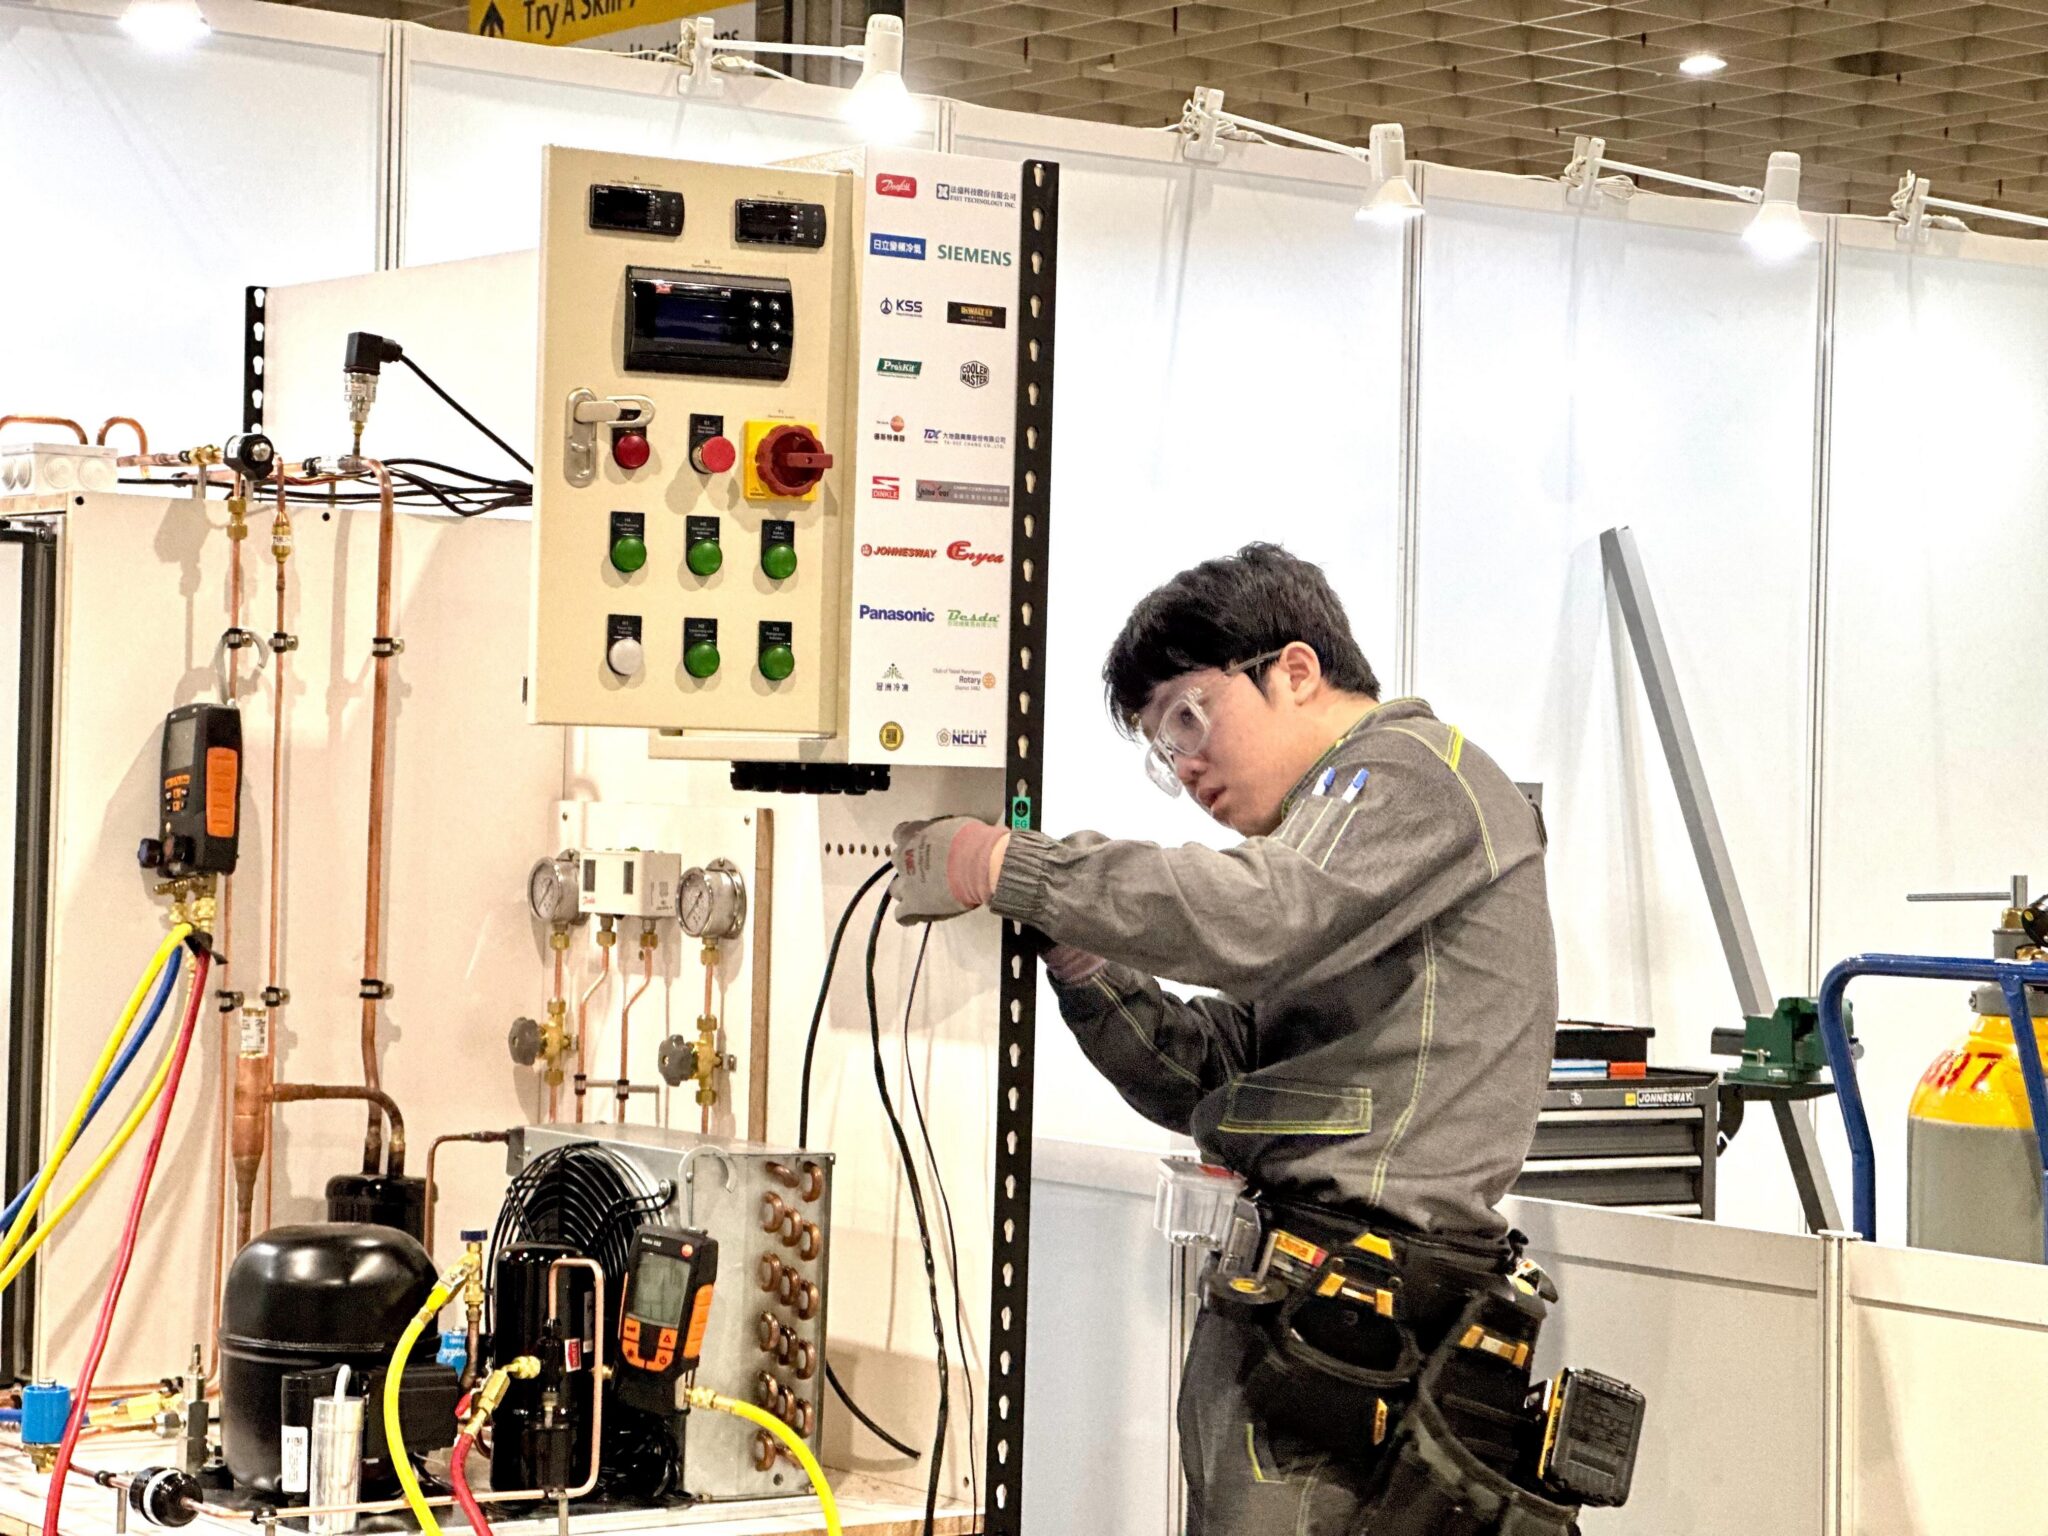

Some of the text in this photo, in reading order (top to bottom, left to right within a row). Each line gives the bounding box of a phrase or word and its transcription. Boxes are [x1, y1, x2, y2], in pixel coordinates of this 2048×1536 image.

[522, 0, 559, 39] Try
[562, 0, 576, 25] A
[937, 244, 1012, 267] SIEMENS
[896, 299, 923, 313] KSS
[961, 363, 988, 375] COOLER
[961, 373, 988, 386] MASTER
[859, 604, 935, 623] Panasonic
[959, 675, 981, 685] Rotary
[952, 734, 987, 745] NCUT
[1014, 819, 1028, 828] EG
[1639, 1092, 1693, 1103] JONNESWAY
